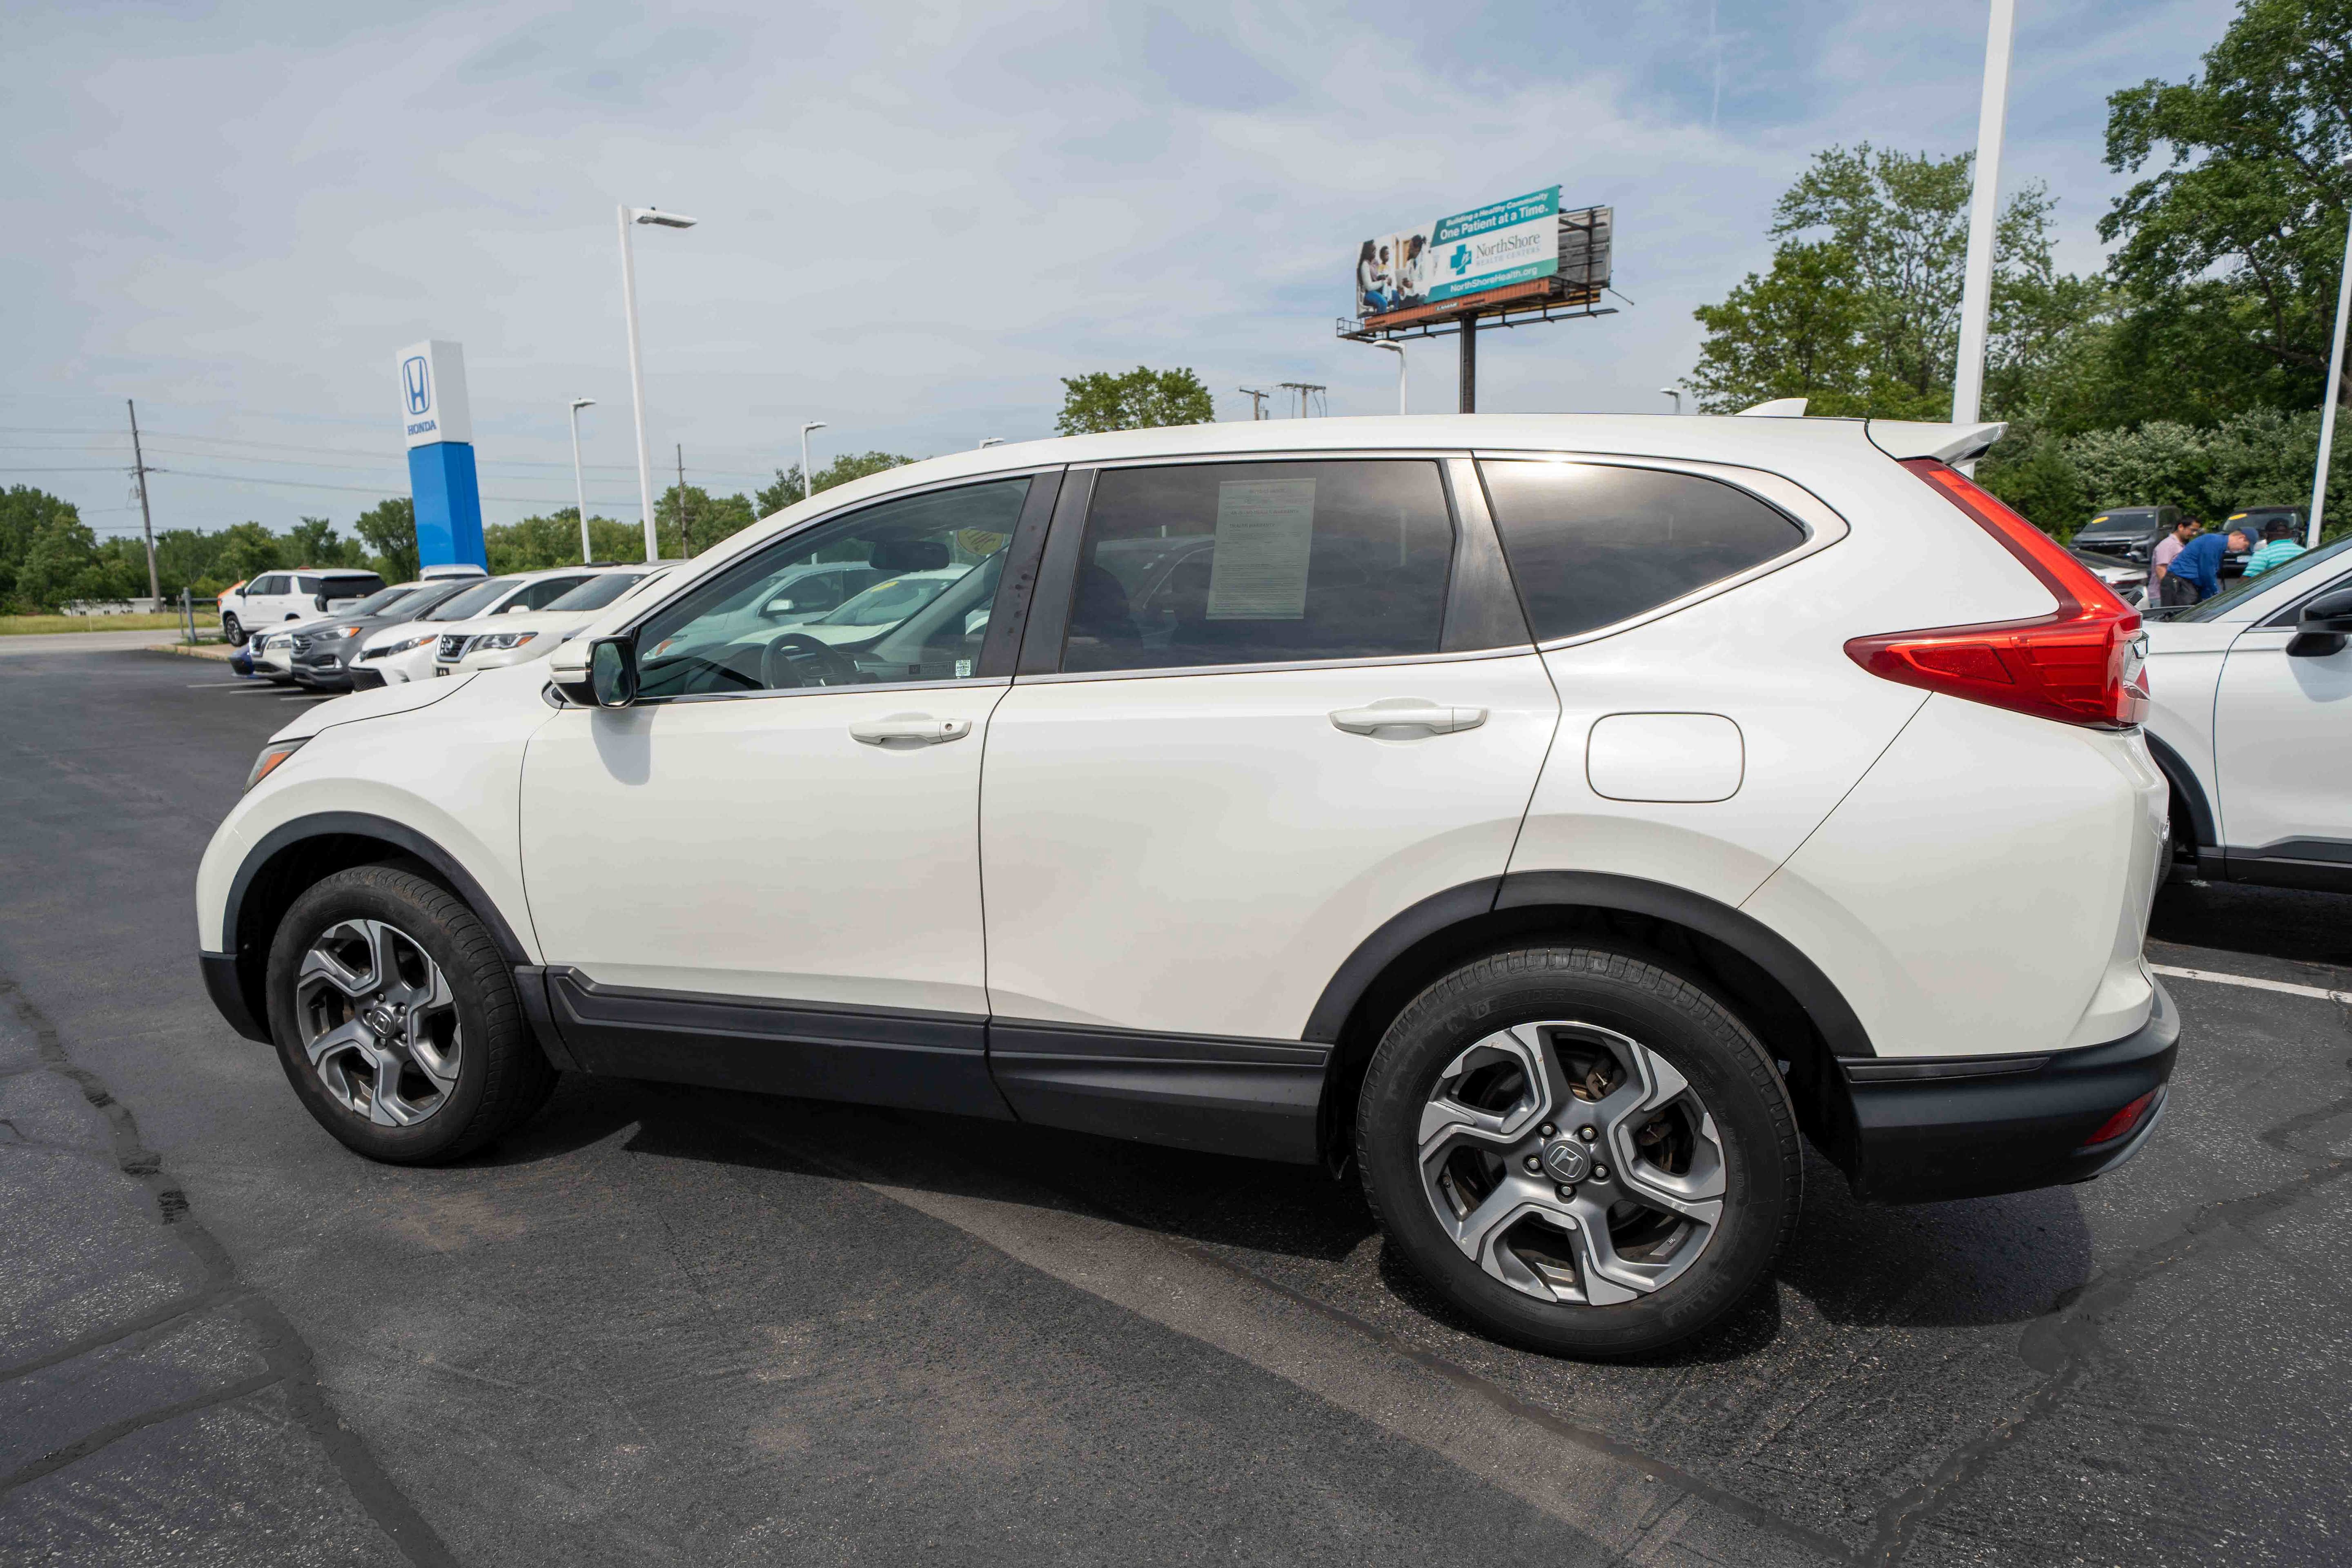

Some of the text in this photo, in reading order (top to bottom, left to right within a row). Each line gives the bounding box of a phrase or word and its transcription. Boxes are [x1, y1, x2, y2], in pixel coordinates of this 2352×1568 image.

[1440, 203, 1549, 240] One Patient at a Time.
[1446, 214, 1474, 227] Building
[1479, 205, 1506, 216] Healthy
[1506, 192, 1549, 209] Community
[1476, 234, 1541, 259] NorthShore
[1476, 246, 1541, 267] HEALTH CENTERS
[1450, 267, 1538, 292] NorthShoreHealth.org
[407, 419, 437, 436] HONDA
